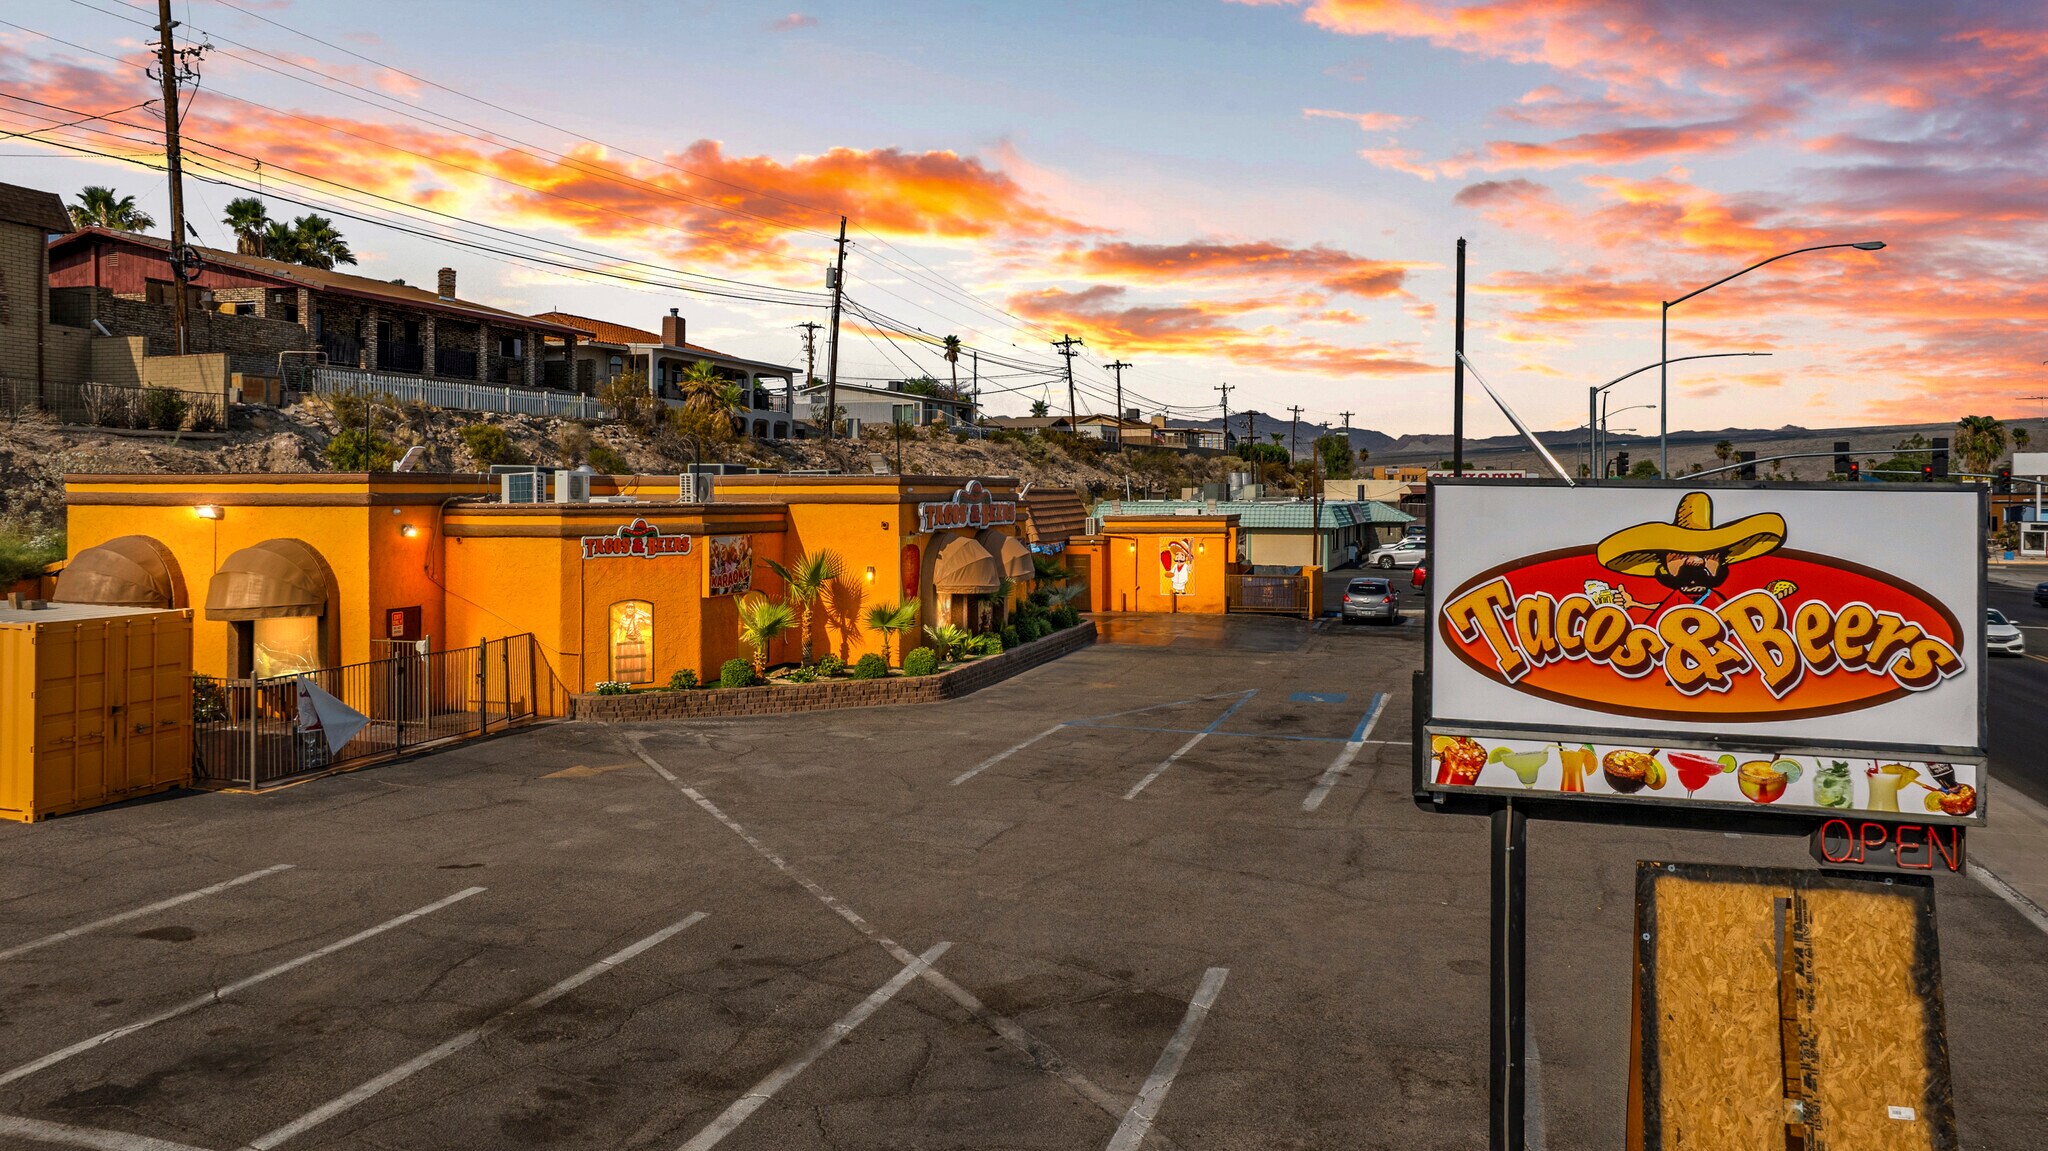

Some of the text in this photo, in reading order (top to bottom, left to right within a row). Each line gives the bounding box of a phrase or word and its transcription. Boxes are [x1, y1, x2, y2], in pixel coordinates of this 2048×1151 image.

[925, 503, 1014, 529] TACOS & BEERS
[584, 536, 690, 557] TACOS & BEERS
[1443, 577, 1964, 699] Tacos & Beers
[1821, 819, 1957, 871] OPEN
